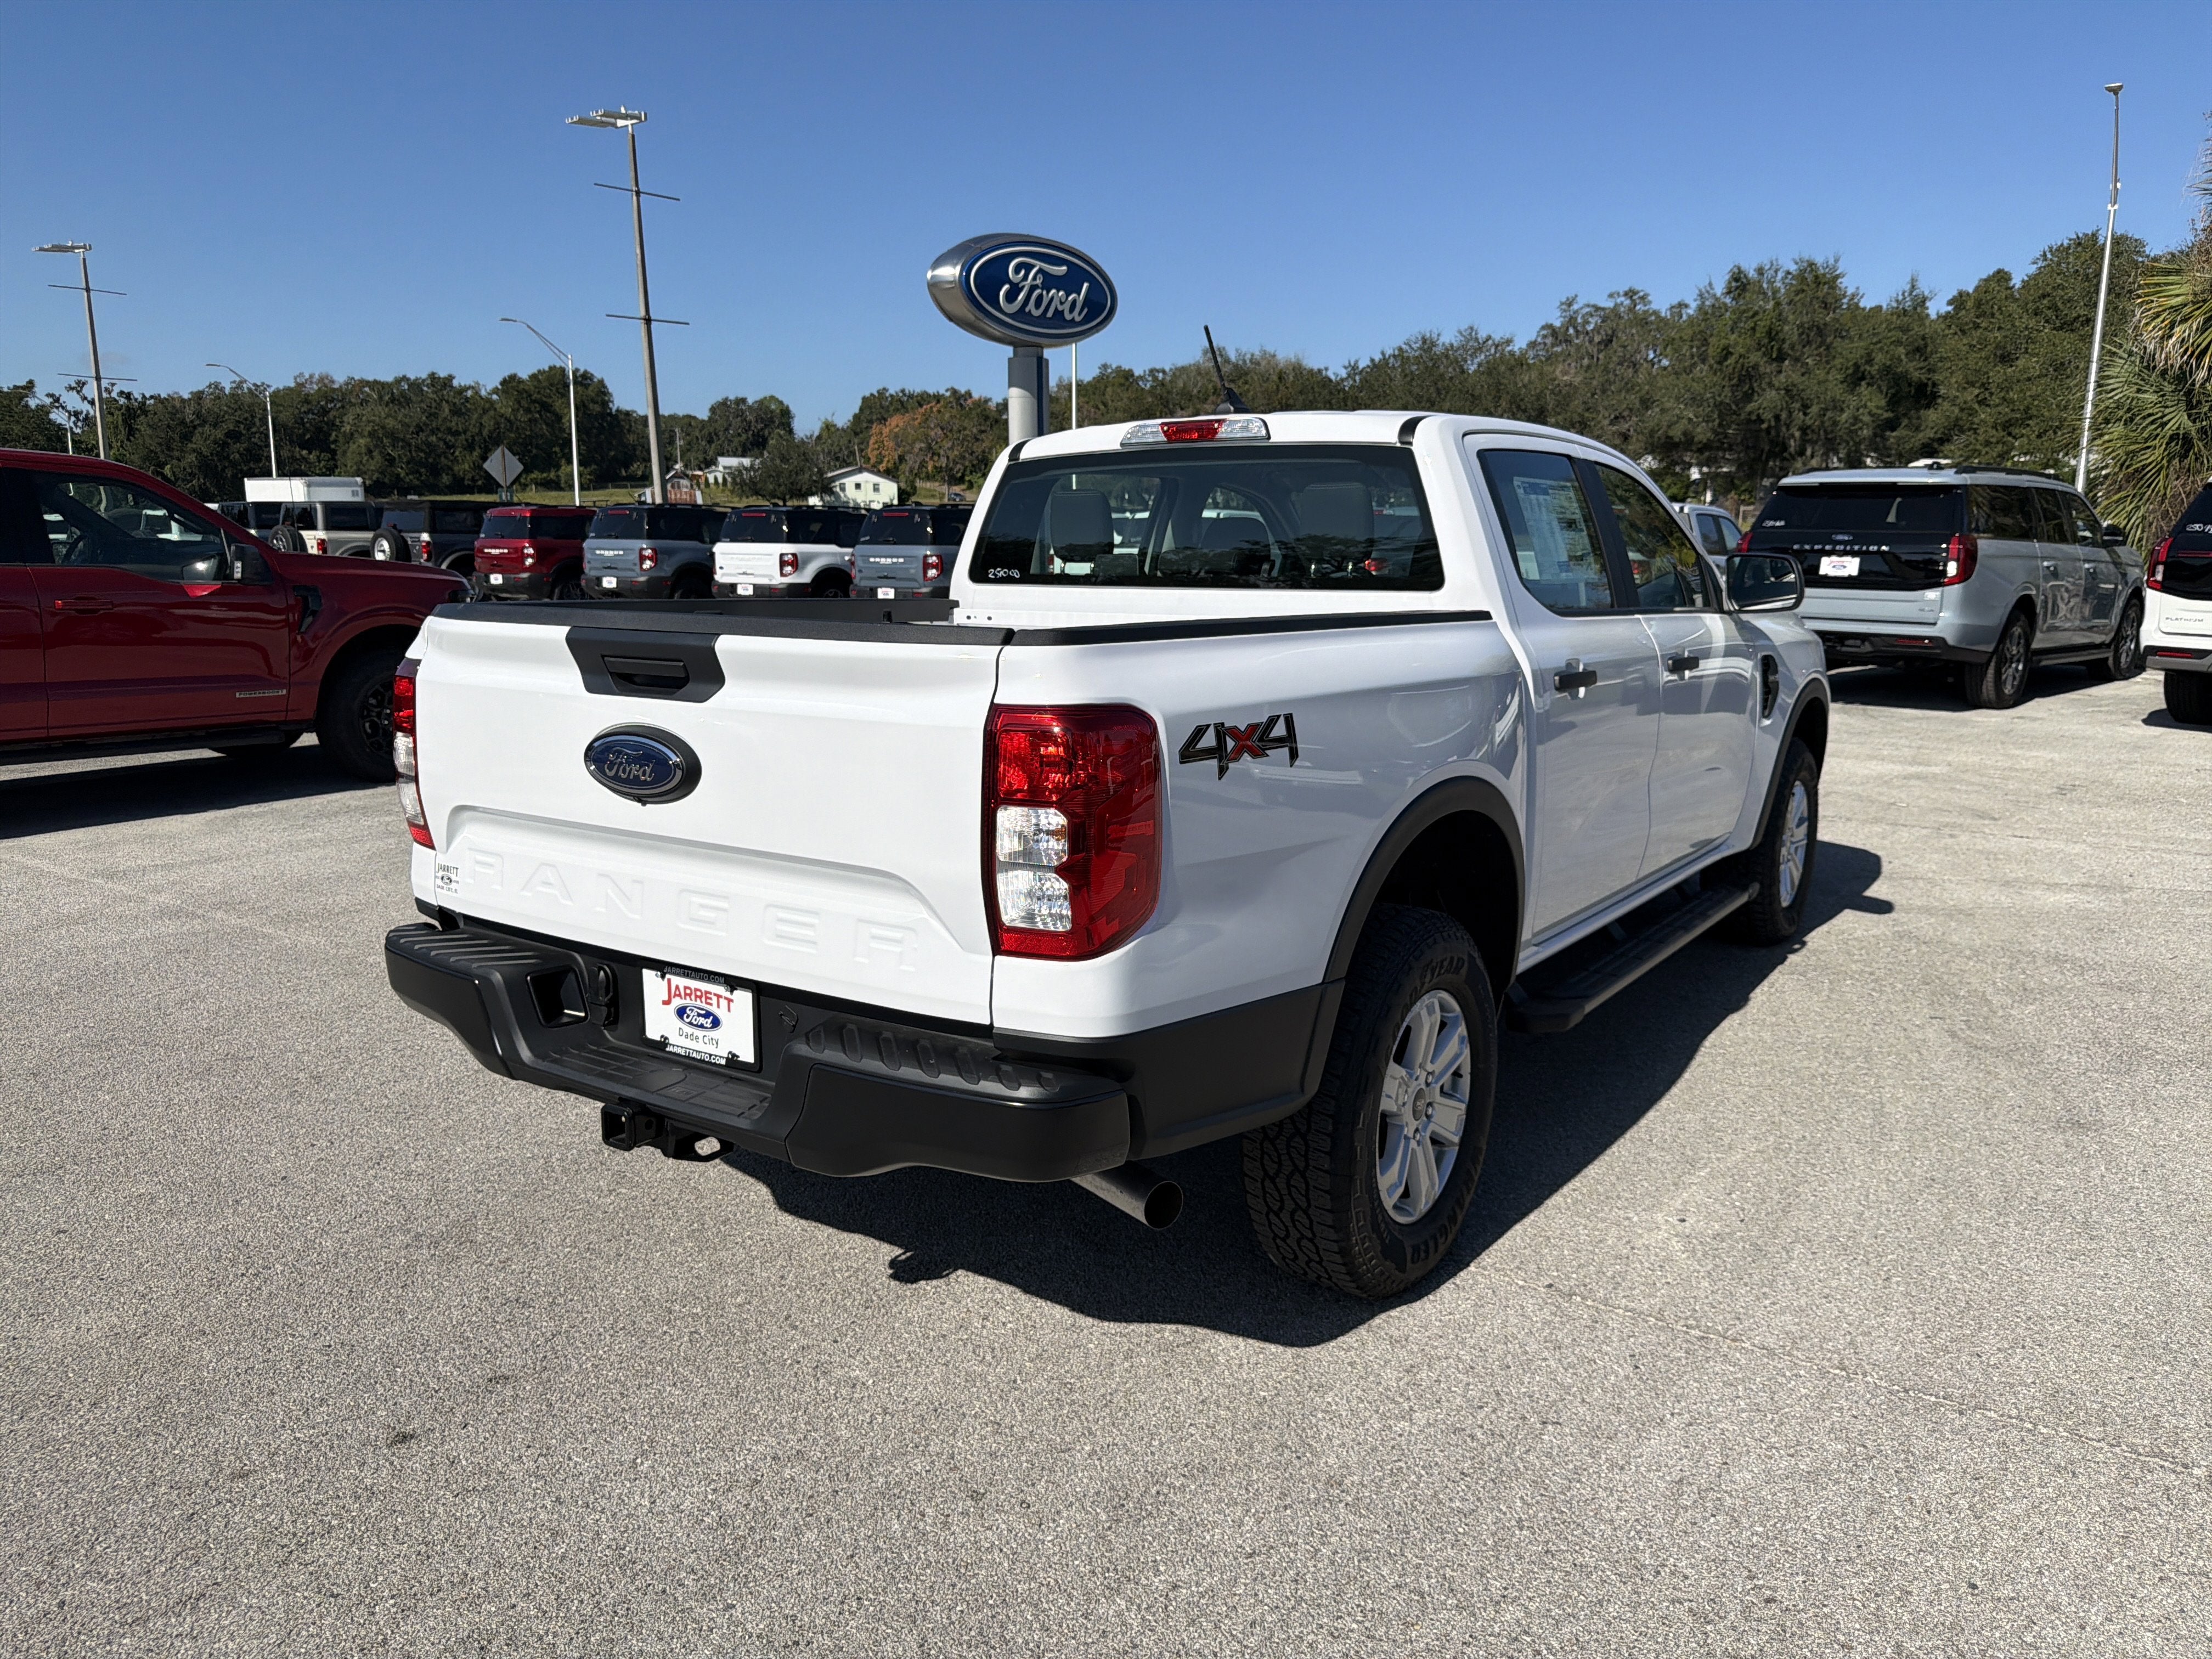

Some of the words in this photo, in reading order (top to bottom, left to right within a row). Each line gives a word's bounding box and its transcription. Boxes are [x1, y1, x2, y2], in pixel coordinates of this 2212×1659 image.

[1000, 257, 1089, 323] Ford
[605, 747, 656, 782] Ford
[436, 862, 459, 877] JARRETT
[465, 848, 919, 972] RANGER
[663, 966, 725, 984] JARRETTAUTO.COM
[683, 1006, 713, 1029] Ford
[678, 1027, 699, 1043] Dade
[703, 1035, 719, 1049] City
[665, 1044, 726, 1065] JARRETTAUTO.COM
